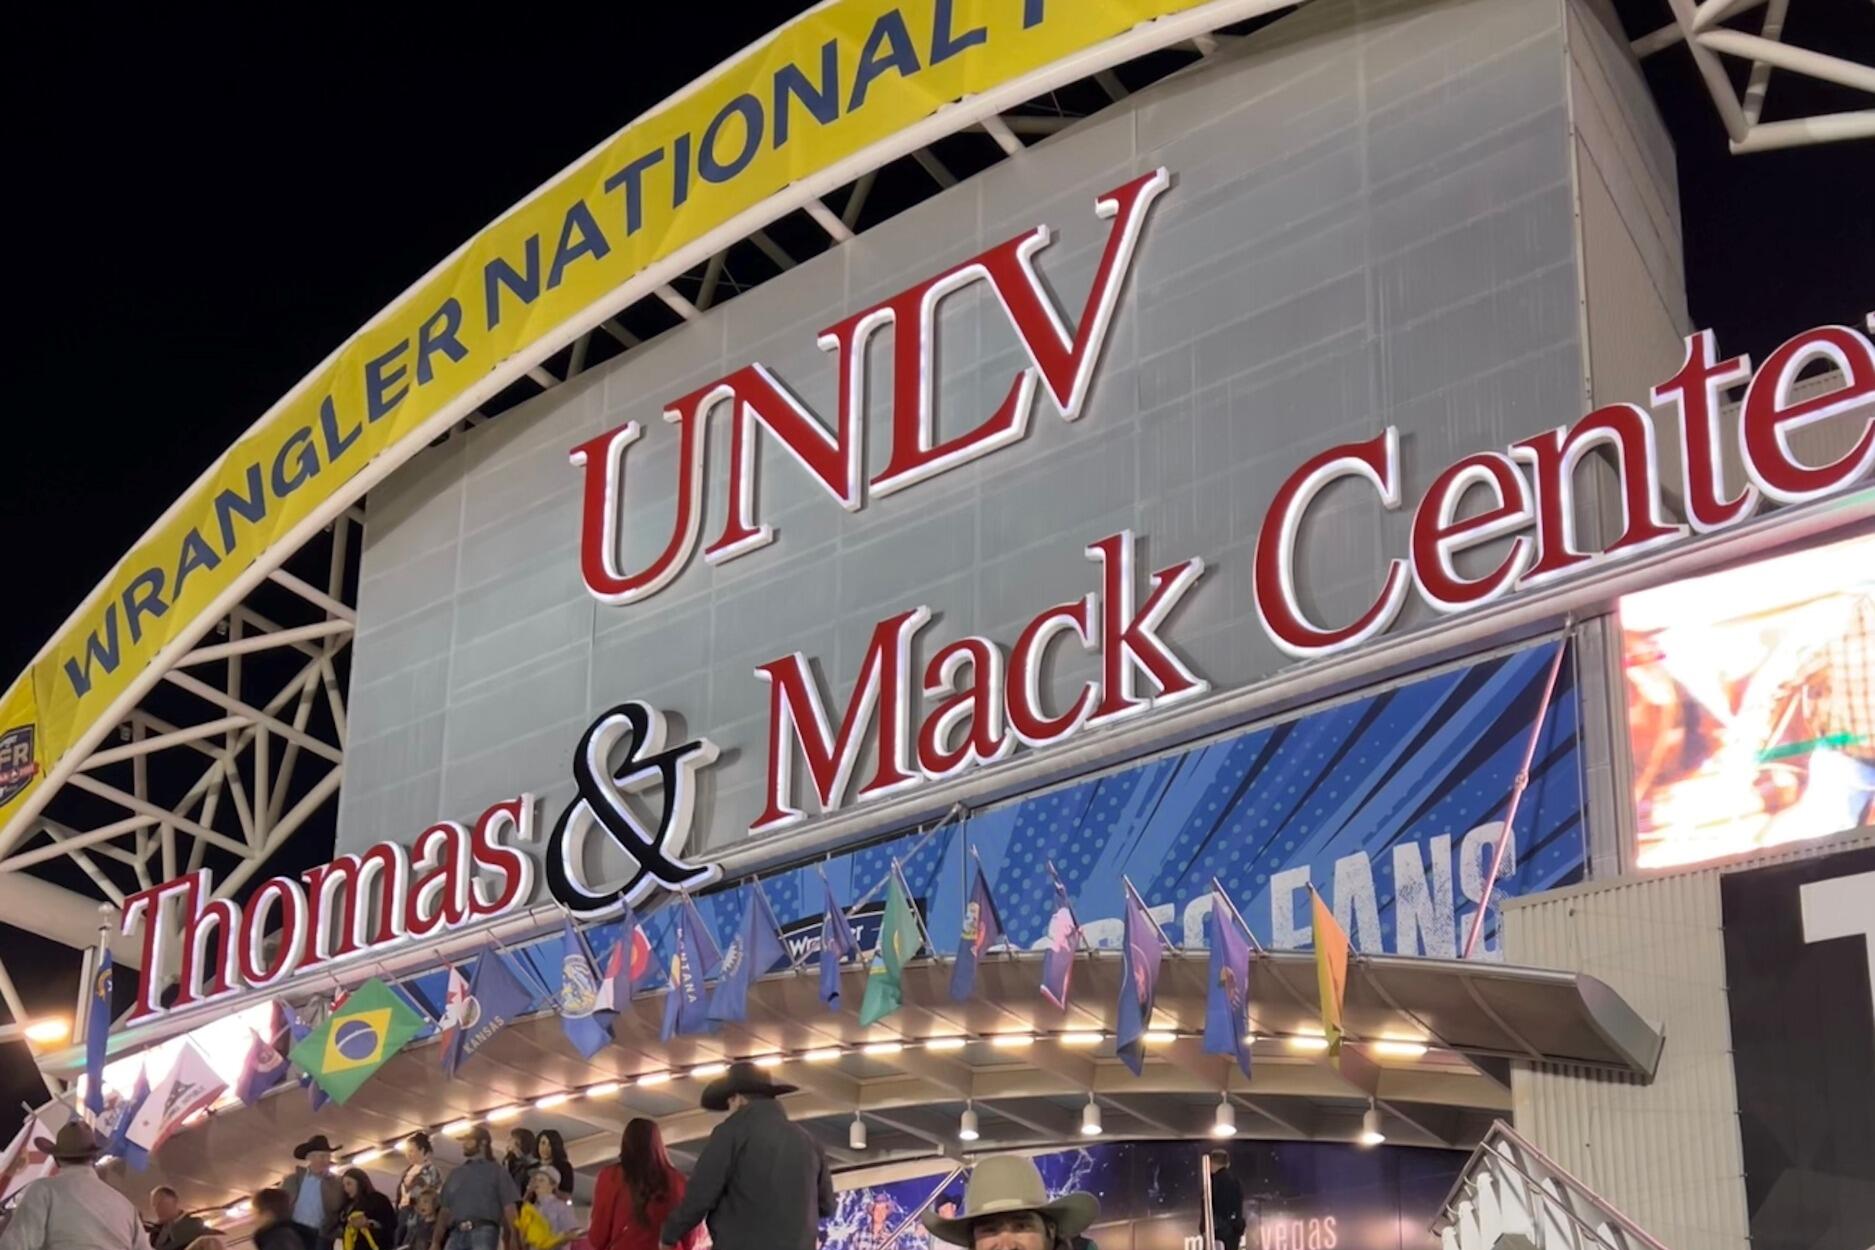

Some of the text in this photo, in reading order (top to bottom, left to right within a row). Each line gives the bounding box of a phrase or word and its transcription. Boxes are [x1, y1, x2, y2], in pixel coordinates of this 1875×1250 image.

[64, 0, 987, 698] WRANGLER NATIONAL
[569, 166, 1170, 606] UNLV
[121, 311, 1875, 1028] Thomas & Mack Cente
[463, 1015, 505, 1056] KANSAS
[1271, 820, 1517, 963] FANS
